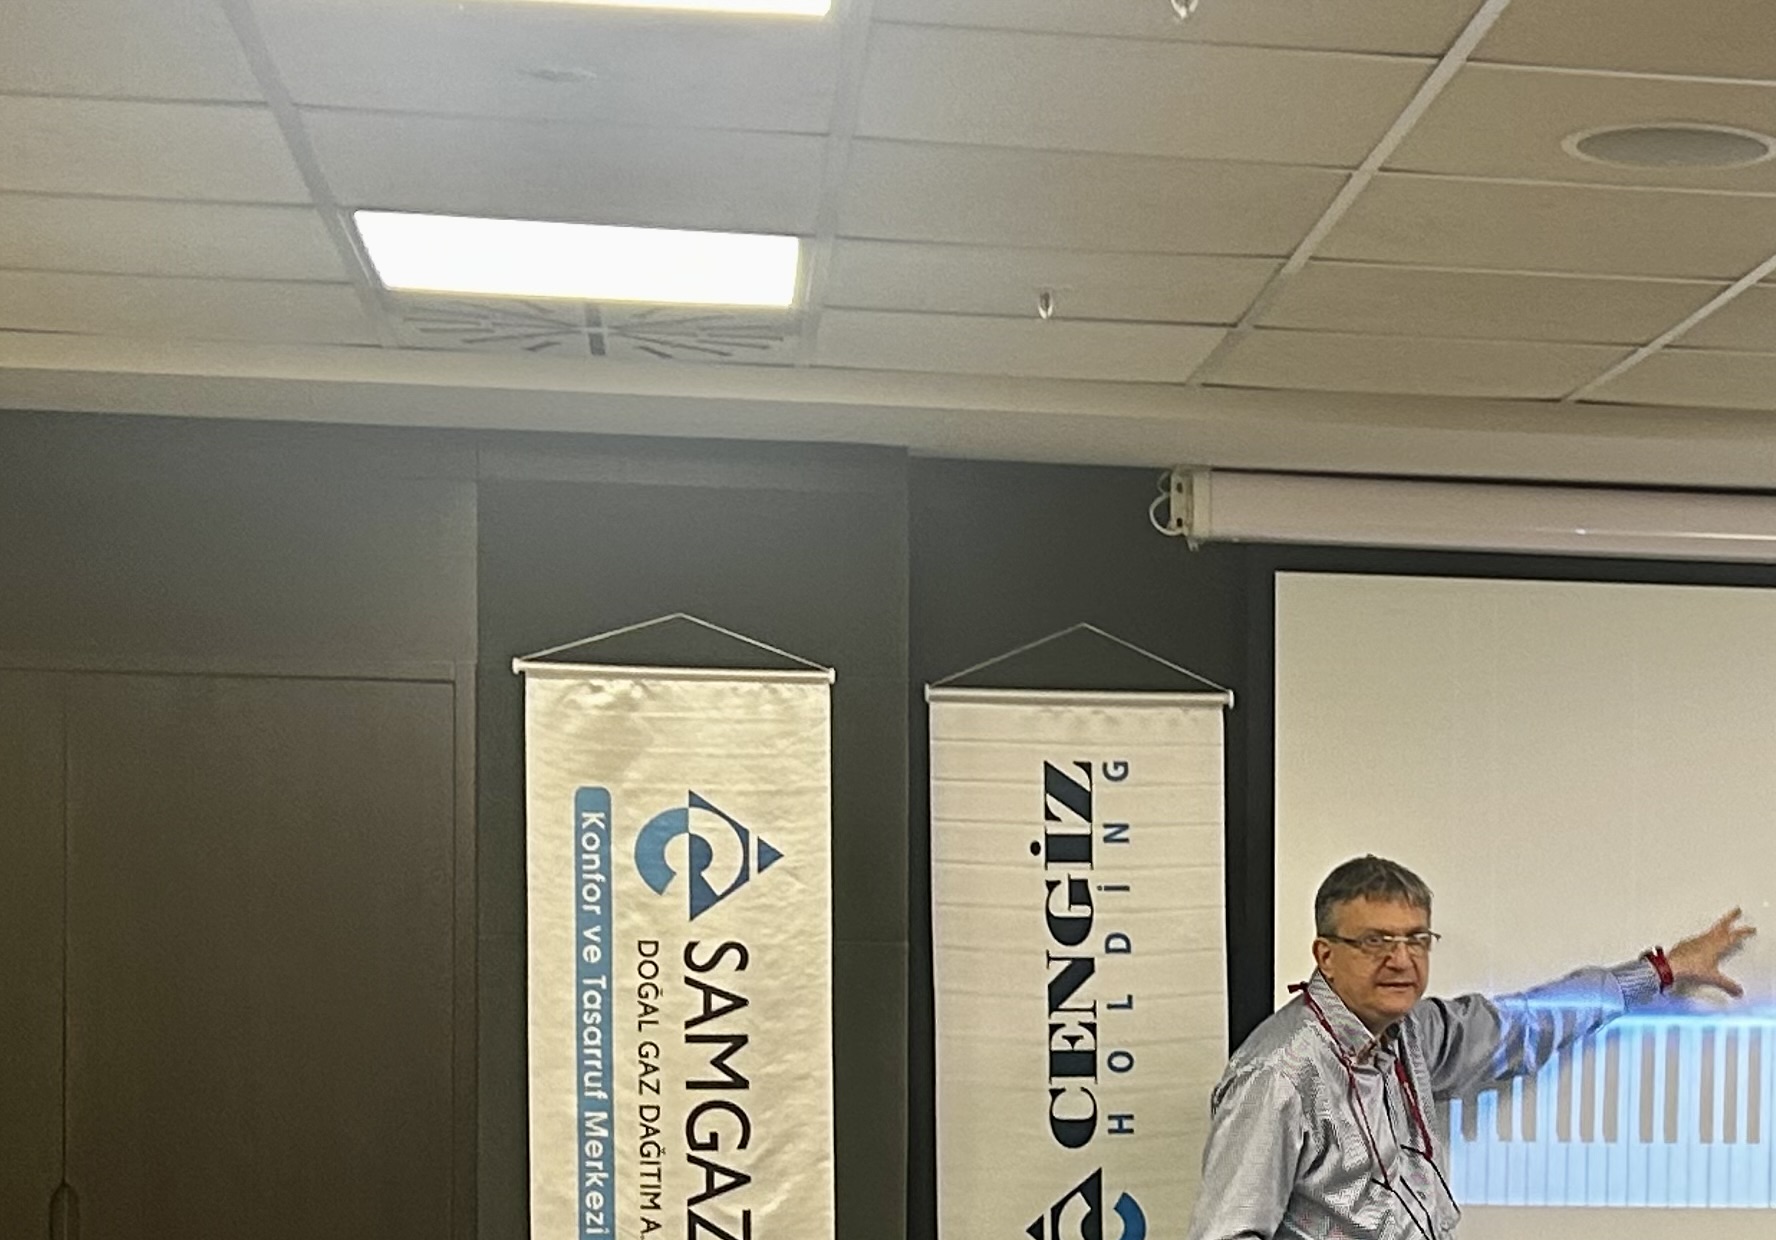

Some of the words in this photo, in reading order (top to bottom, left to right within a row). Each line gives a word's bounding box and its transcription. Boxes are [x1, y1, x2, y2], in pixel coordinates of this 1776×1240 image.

[580, 811, 607, 916] Konfor
[582, 925, 602, 963] ve
[637, 940, 663, 1032] DOĞAL
[1030, 760, 1098, 1149] CENGİZ
[1097, 760, 1135, 1135] HOLDİNG
[582, 975, 608, 1100] Tasarruf
[638, 1041, 660, 1095] GAZ
[583, 1110, 610, 1235] Merkezi
[639, 1104, 665, 1211] DAĞITIM
